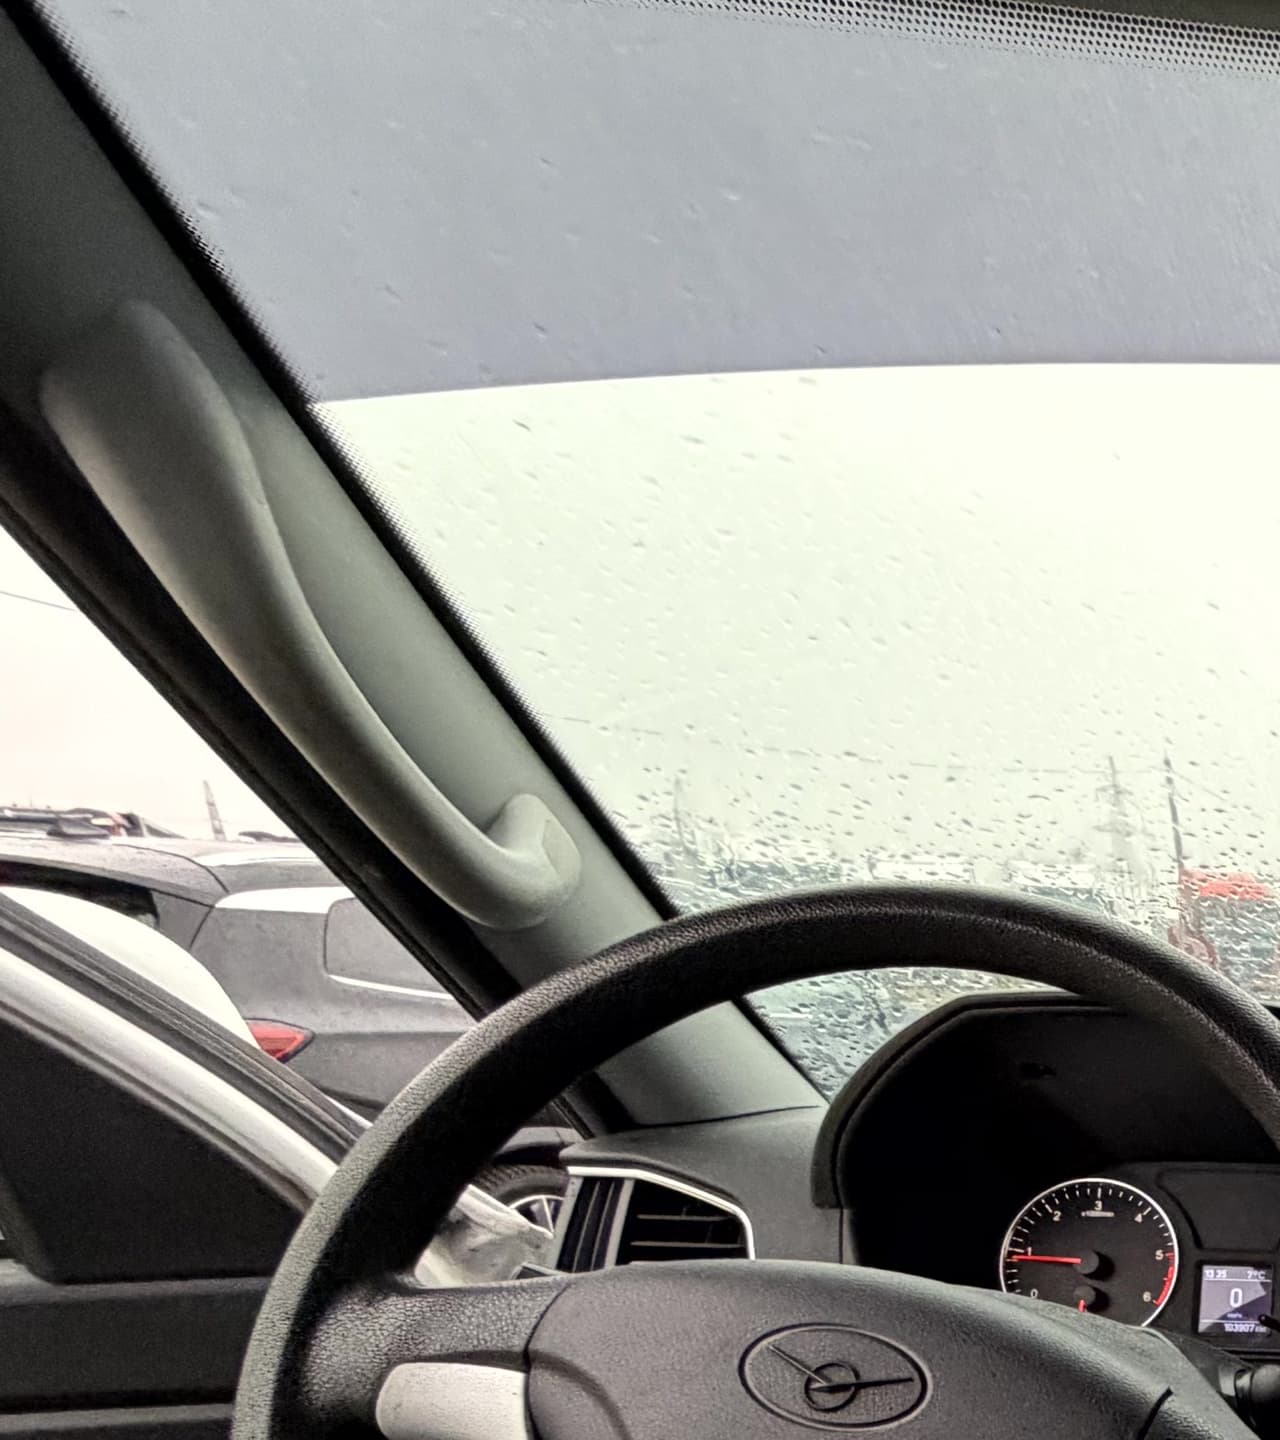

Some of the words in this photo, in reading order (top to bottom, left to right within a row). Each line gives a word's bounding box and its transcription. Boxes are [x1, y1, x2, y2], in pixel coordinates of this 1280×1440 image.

[1094, 1200, 1103, 1211] 3
[1052, 1210, 1062, 1222] 2
[1134, 1213, 1143, 1224] 4
[1155, 1250, 1164, 1261] 5
[1142, 1291, 1152, 1303] 6
[1230, 1287, 1243, 1308] 0
